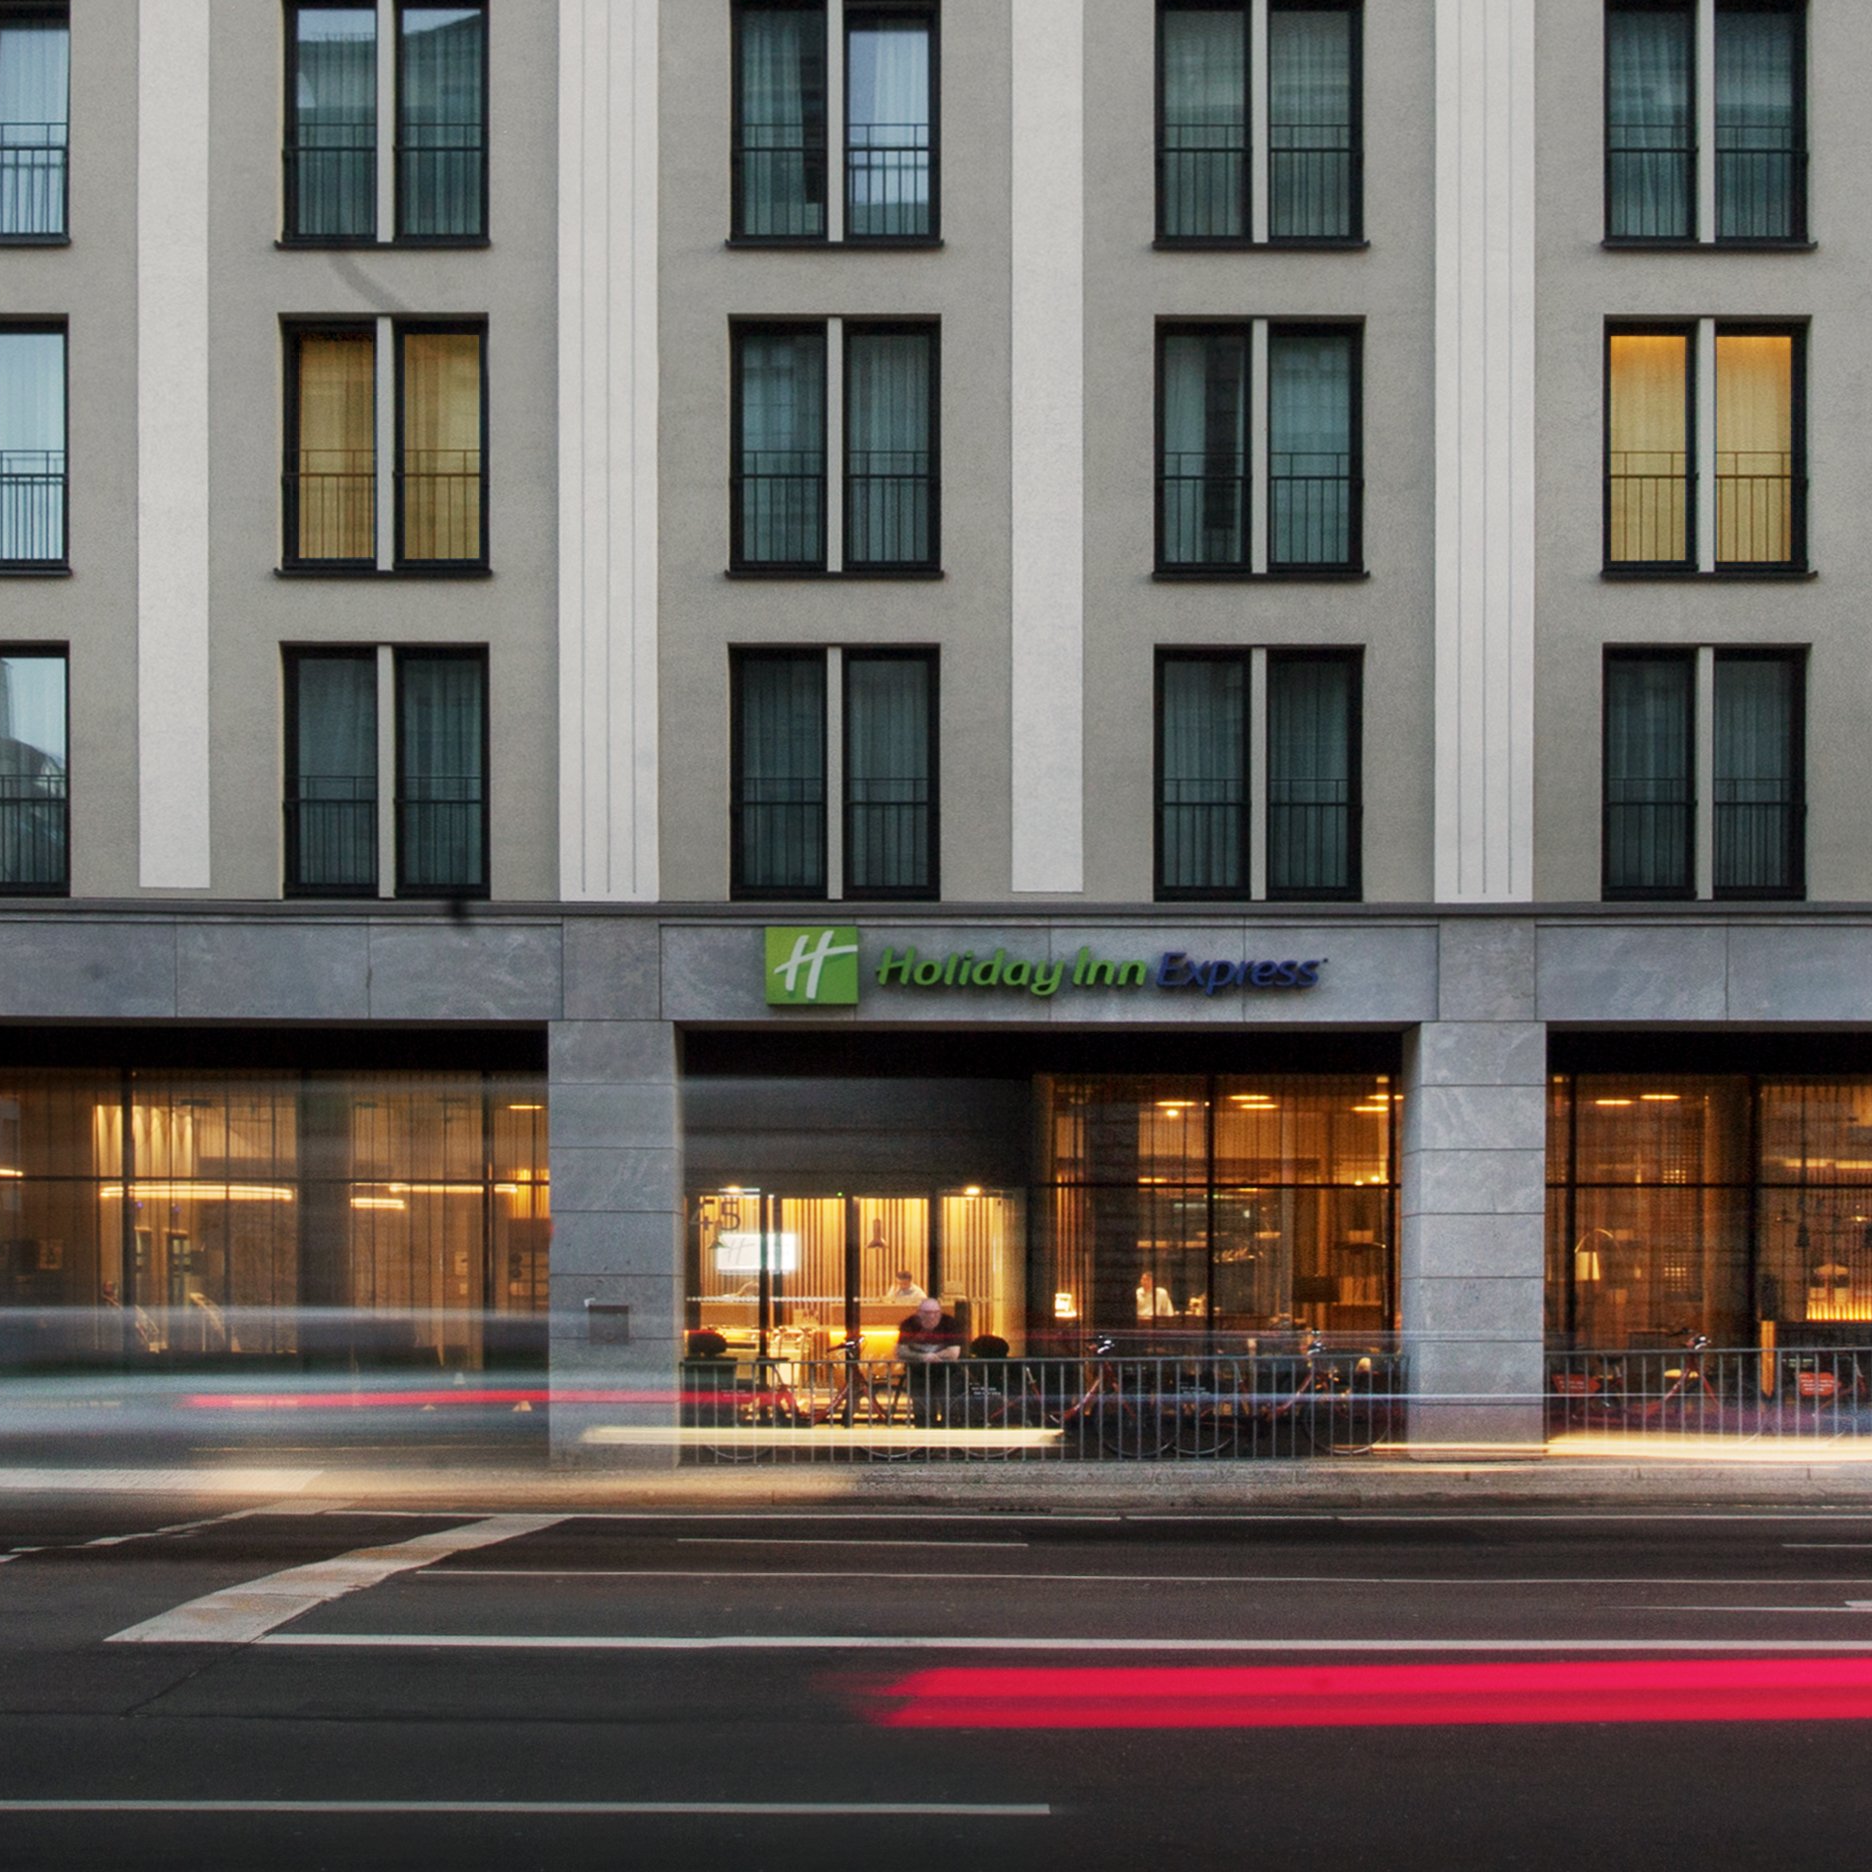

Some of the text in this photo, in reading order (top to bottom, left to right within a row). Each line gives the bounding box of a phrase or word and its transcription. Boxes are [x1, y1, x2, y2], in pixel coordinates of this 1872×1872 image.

[773, 930, 858, 999] H
[876, 945, 1321, 997] Holiday Inn Express
